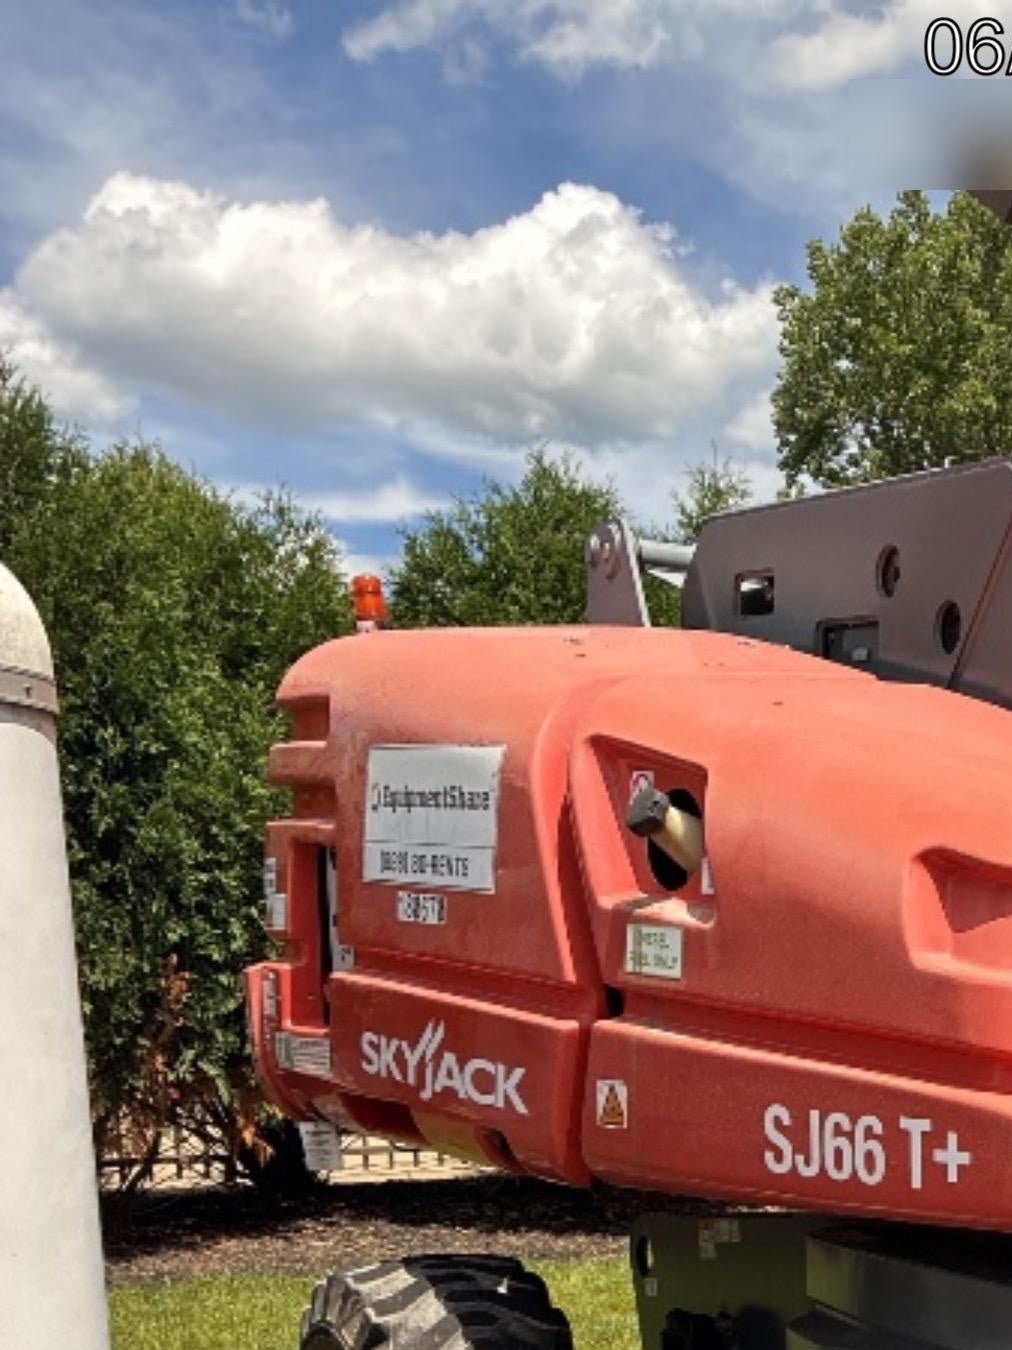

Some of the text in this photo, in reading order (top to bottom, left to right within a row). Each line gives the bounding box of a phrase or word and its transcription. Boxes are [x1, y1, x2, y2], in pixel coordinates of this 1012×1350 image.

[383, 785, 489, 814] EquipmentShare
[360, 1017, 529, 1115] SKYJACK
[764, 1103, 973, 1189] SJ66 T+
